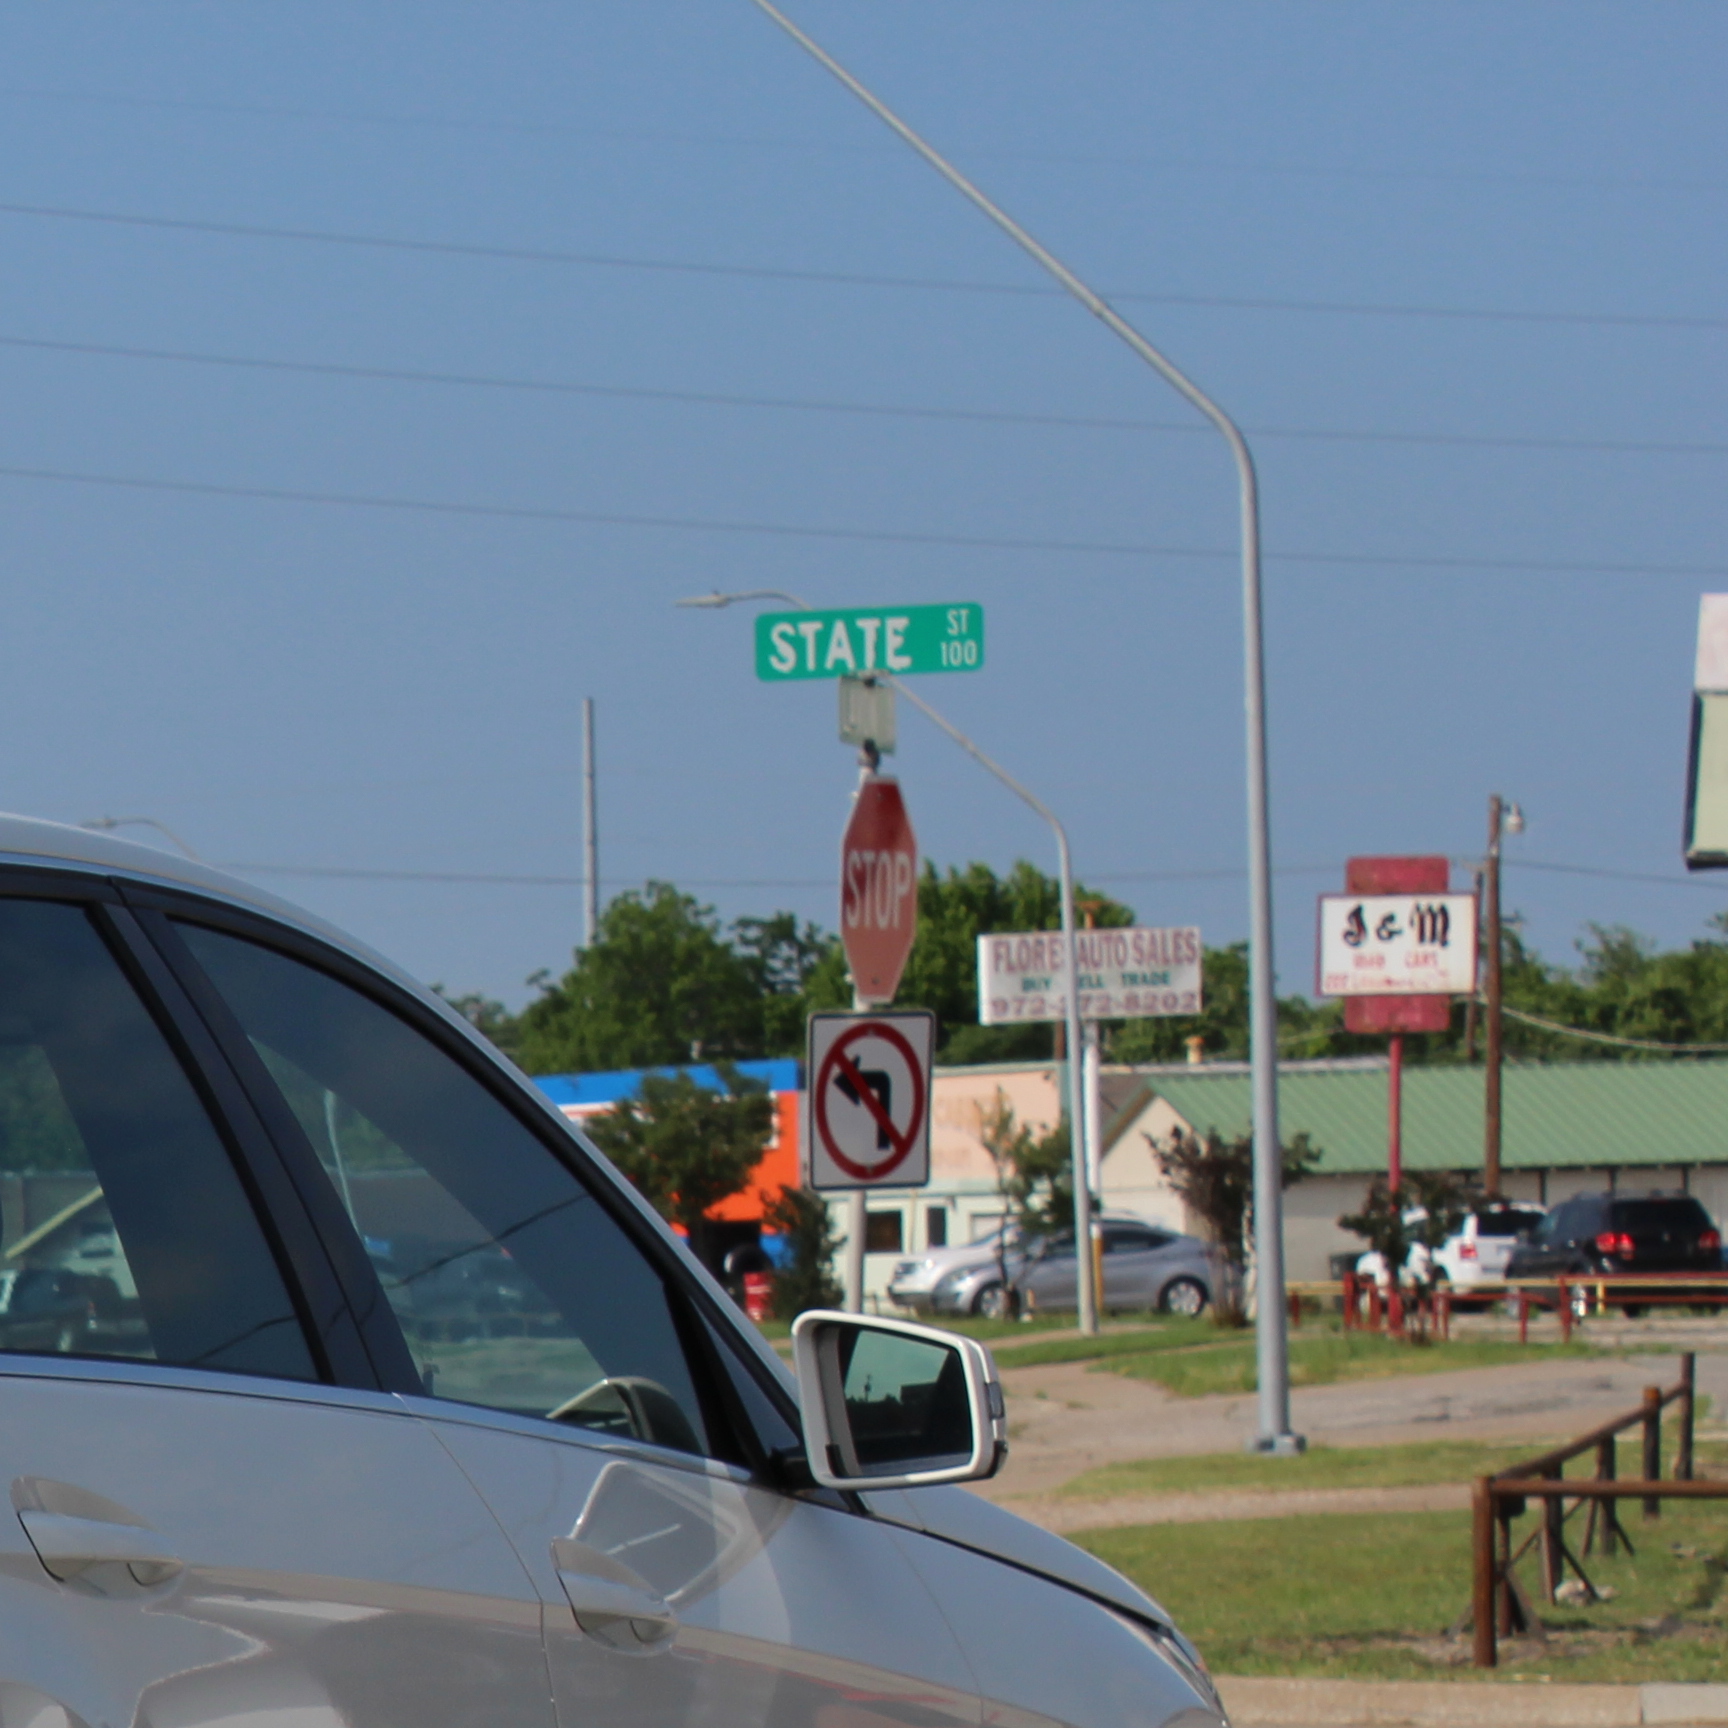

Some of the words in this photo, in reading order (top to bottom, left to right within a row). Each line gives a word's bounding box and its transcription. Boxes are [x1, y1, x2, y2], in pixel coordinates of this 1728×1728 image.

[769, 616, 913, 673] STATE
[946, 608, 971, 636] ST
[940, 639, 978, 667] 100
[846, 851, 912, 929] STOP
[1376, 911, 1404, 941] &
[1409, 901, 1451, 948] M
[993, 937, 1064, 974] FLORE
[1077, 933, 1128, 968] AUTO
[1132, 929, 1198, 966] SALES
[1021, 977, 1052, 991] BUY
[1076, 974, 1106, 990] ELL
[1121, 971, 1171, 986] TRADE
